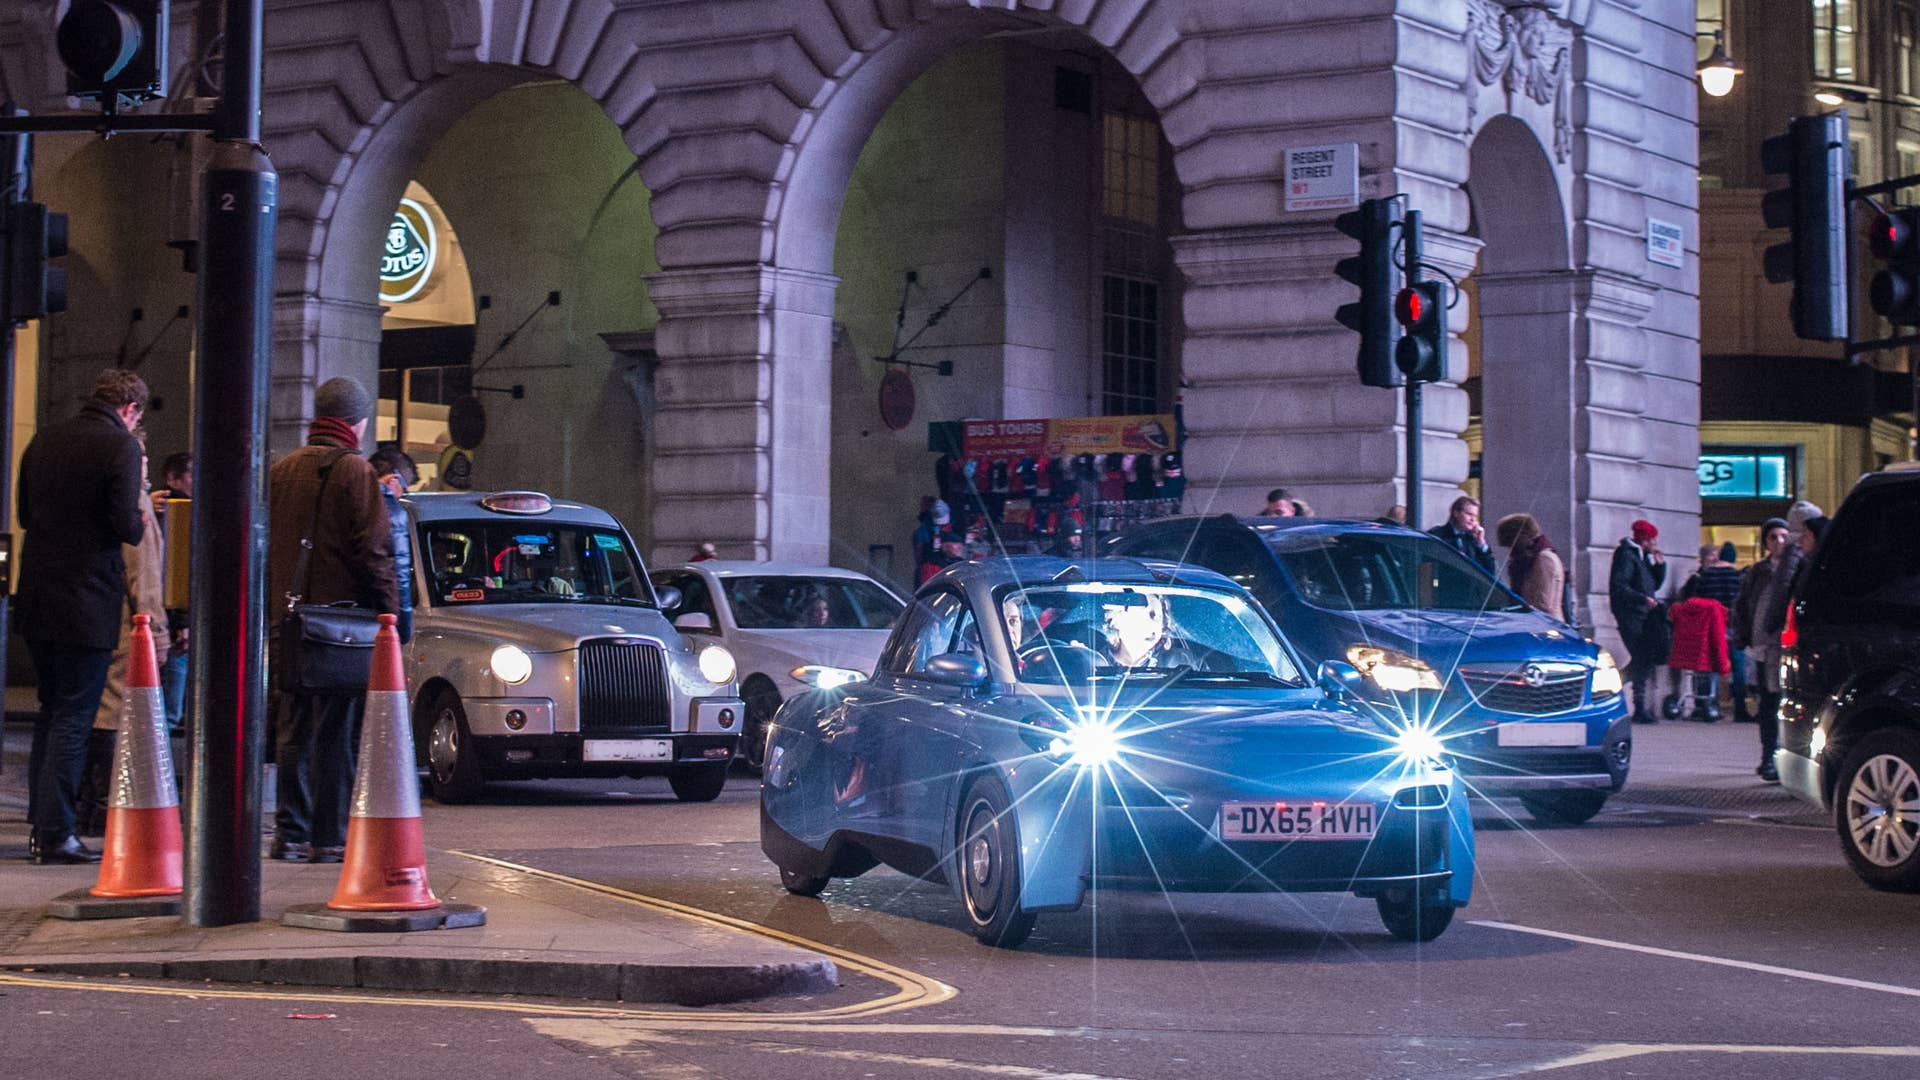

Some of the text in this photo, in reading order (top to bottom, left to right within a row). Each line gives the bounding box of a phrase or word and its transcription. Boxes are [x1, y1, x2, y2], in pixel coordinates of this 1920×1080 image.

[1291, 149, 1336, 165] REGENT
[1291, 165, 1333, 180] STREET
[221, 192, 235, 211] 2
[380, 247, 425, 273] OTUS
[967, 422, 1044, 437] BUS TOURS
[1698, 460, 1734, 485] GG
[1240, 806, 1371, 834] DX65 HVH
